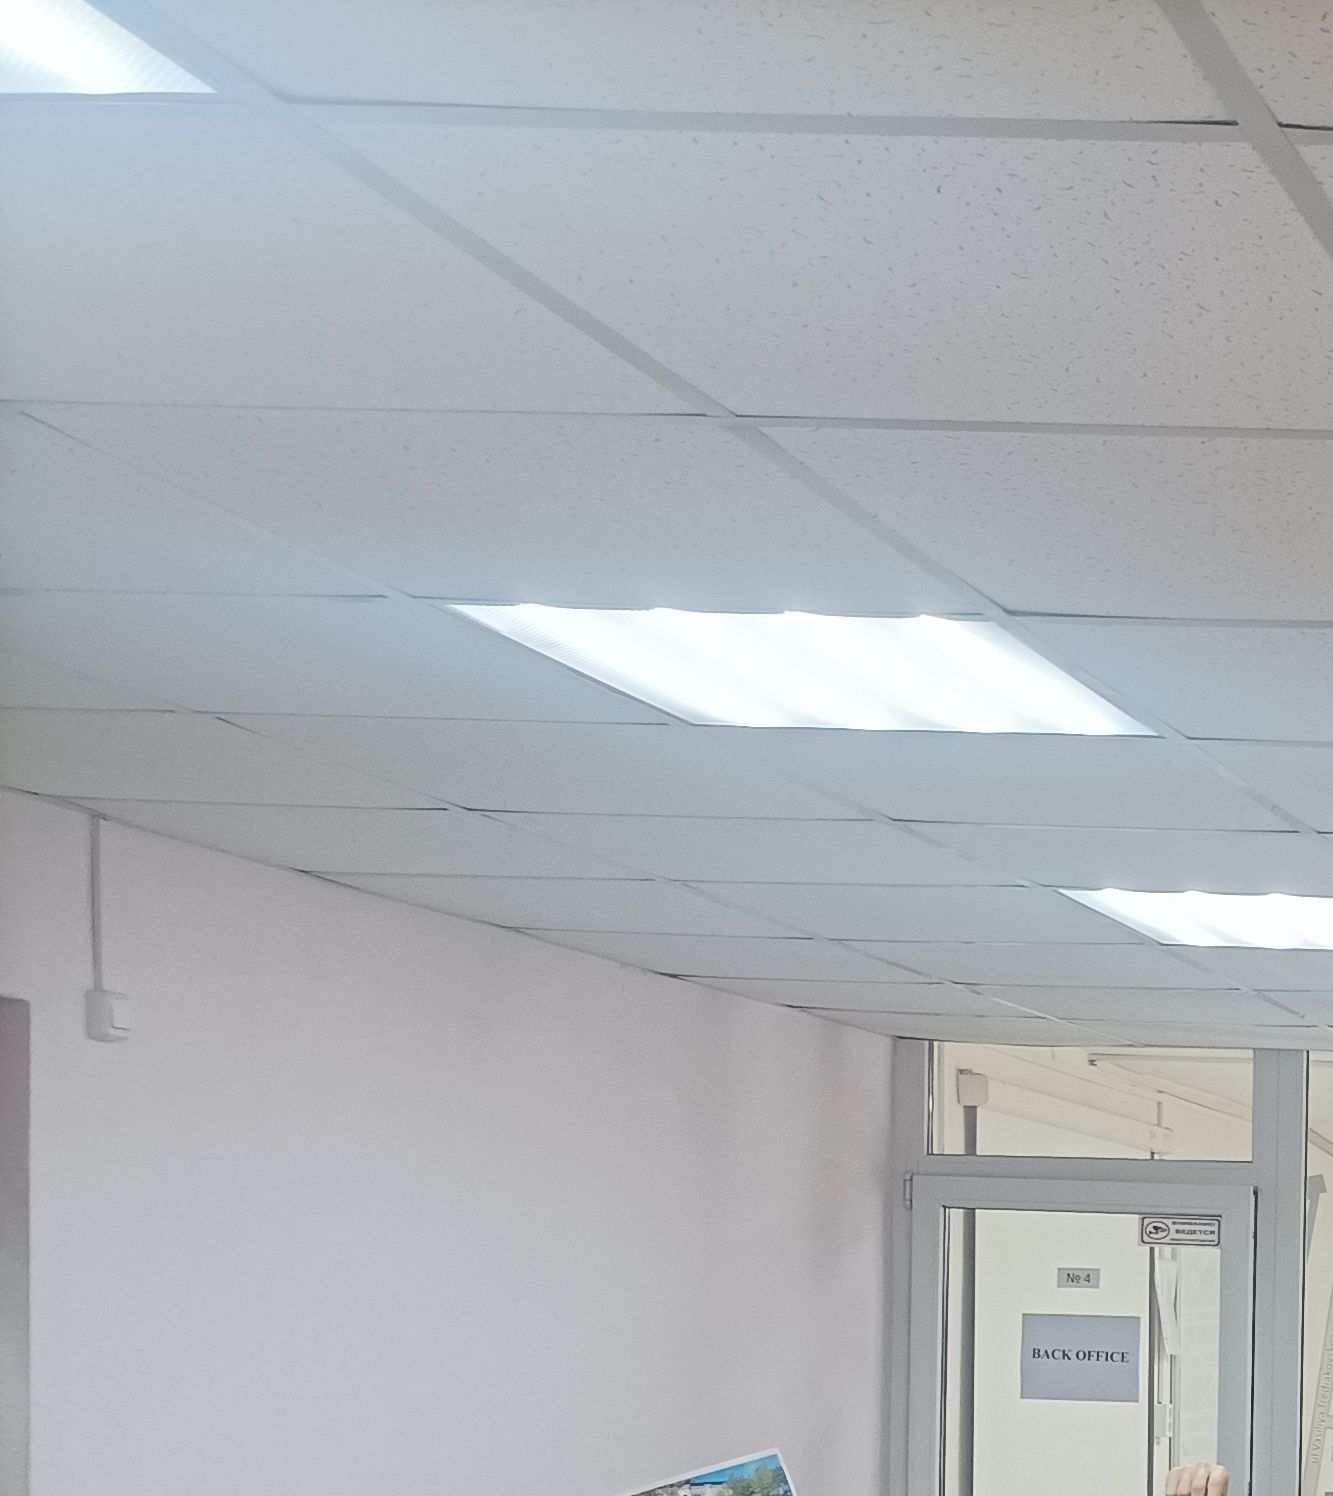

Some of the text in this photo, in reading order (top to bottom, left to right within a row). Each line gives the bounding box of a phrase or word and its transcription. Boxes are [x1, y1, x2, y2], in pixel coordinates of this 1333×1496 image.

[1084, 1273, 1091, 1283] 4
[1032, 1347, 1130, 1363] BACK OFFICE
